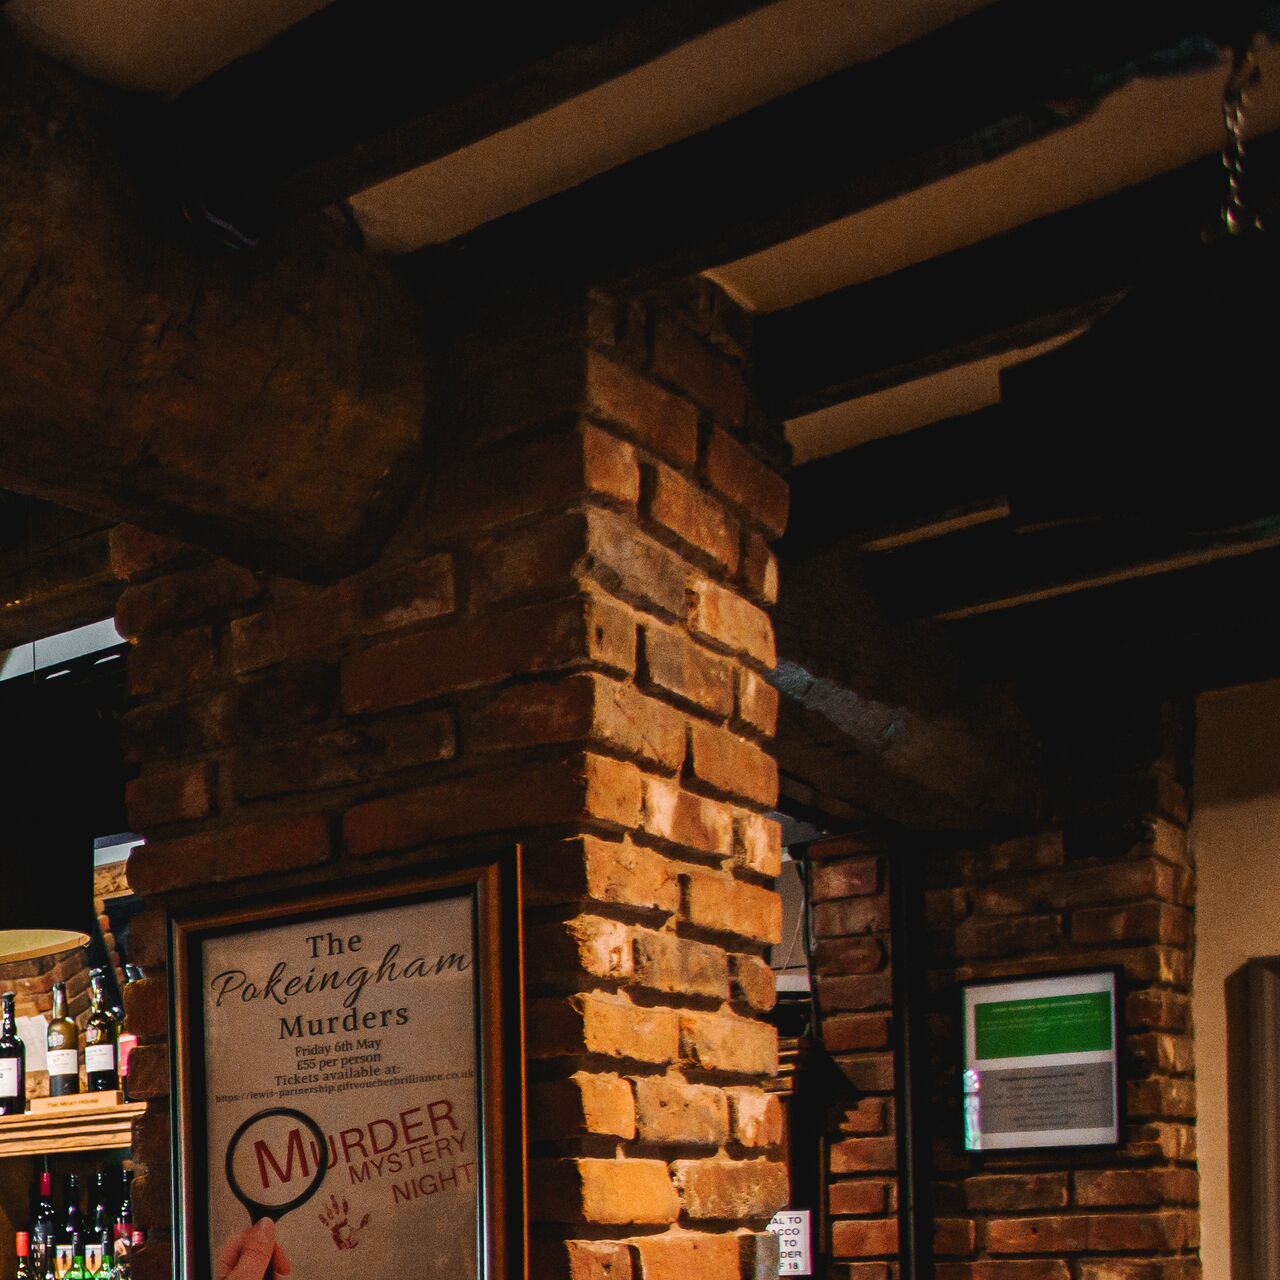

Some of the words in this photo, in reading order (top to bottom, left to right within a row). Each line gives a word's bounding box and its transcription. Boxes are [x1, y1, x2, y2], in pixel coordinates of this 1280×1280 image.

[306, 932, 362, 958] The
[278, 1006, 410, 1041] Murders
[294, 1045, 332, 1058] Friday
[334, 1041, 353, 1052] 6th
[356, 1038, 383, 1051] May
[296, 1059, 317, 1072] £55
[318, 1058, 339, 1072] per
[340, 1052, 382, 1068] person
[274, 1073, 319, 1087] Tickets
[321, 1065, 381, 1083] available
[383, 1064, 401, 1077] at:
[253, 1099, 460, 1190] MURDER
[347, 1131, 468, 1186] MYSTERY
[390, 1161, 476, 1204] NIGHT
[787, 1216, 802, 1225] TO
[783, 1239, 797, 1247] TO
[780, 1250, 803, 1259] DER
[787, 1261, 800, 1270] 18
